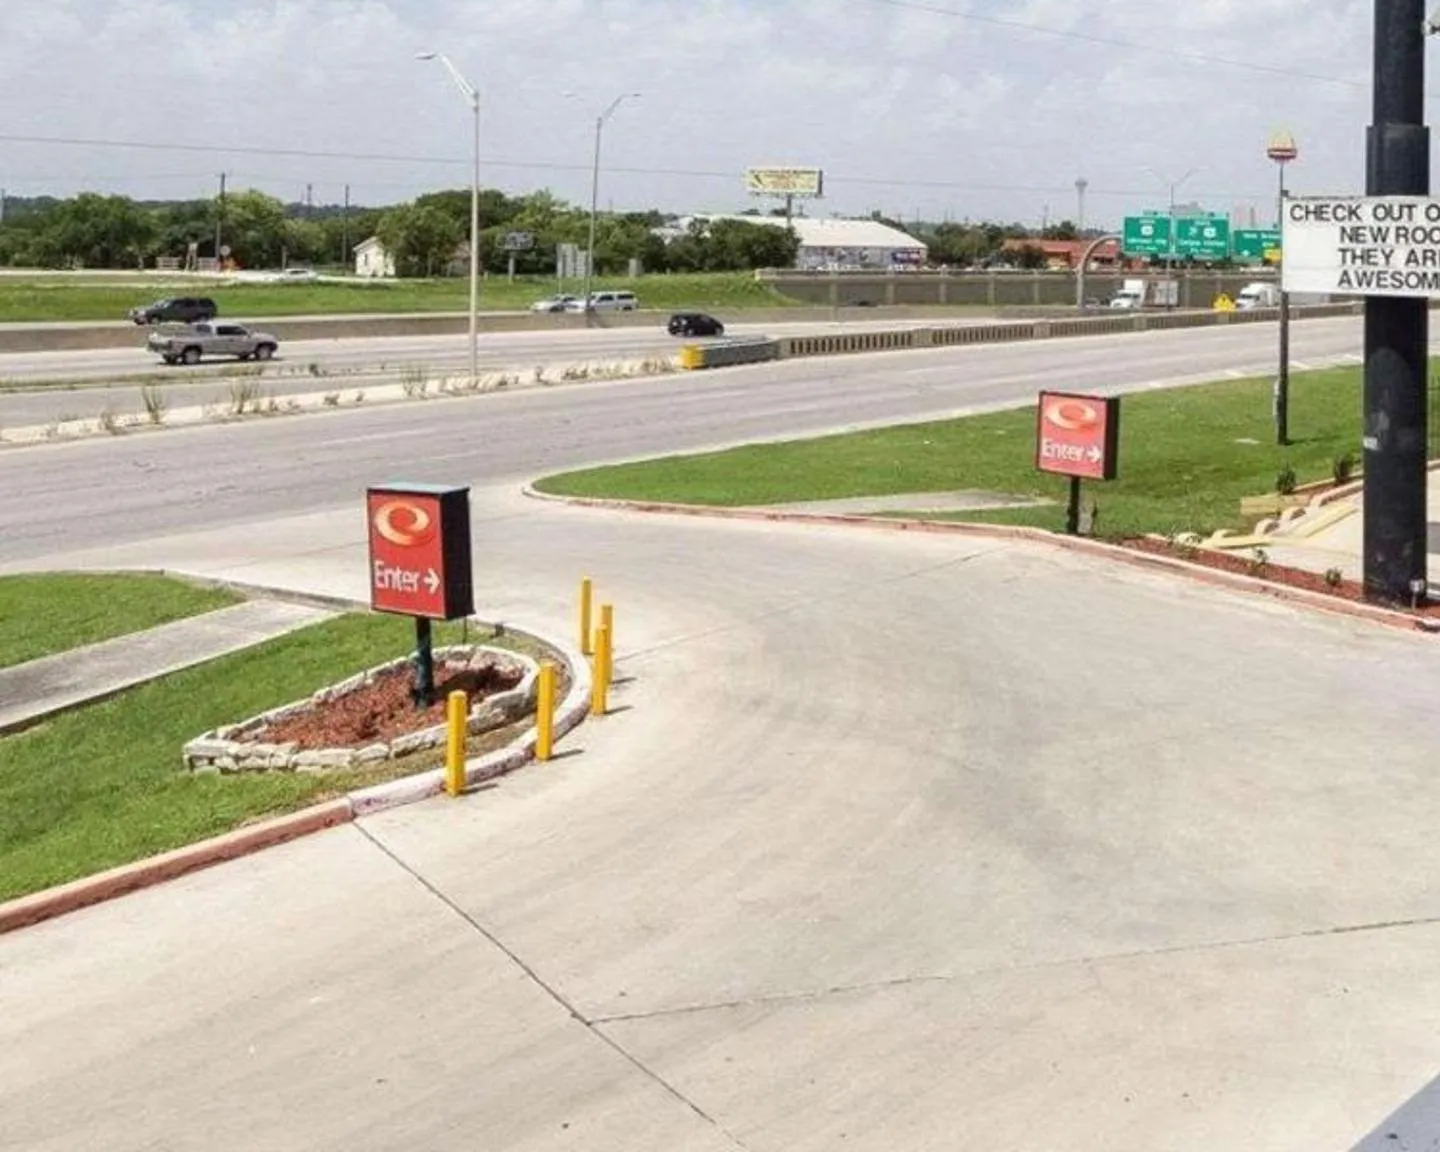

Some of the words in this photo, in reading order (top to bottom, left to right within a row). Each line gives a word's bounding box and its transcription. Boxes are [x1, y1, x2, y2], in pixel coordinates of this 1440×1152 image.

[1290, 203, 1362, 222] CHECK
[1372, 203, 1418, 222] OUT
[1340, 226, 1390, 244] NEW
[1337, 248, 1394, 266] THEY
[1041, 438, 1085, 461] Enter
[374, 560, 421, 593] Enter
